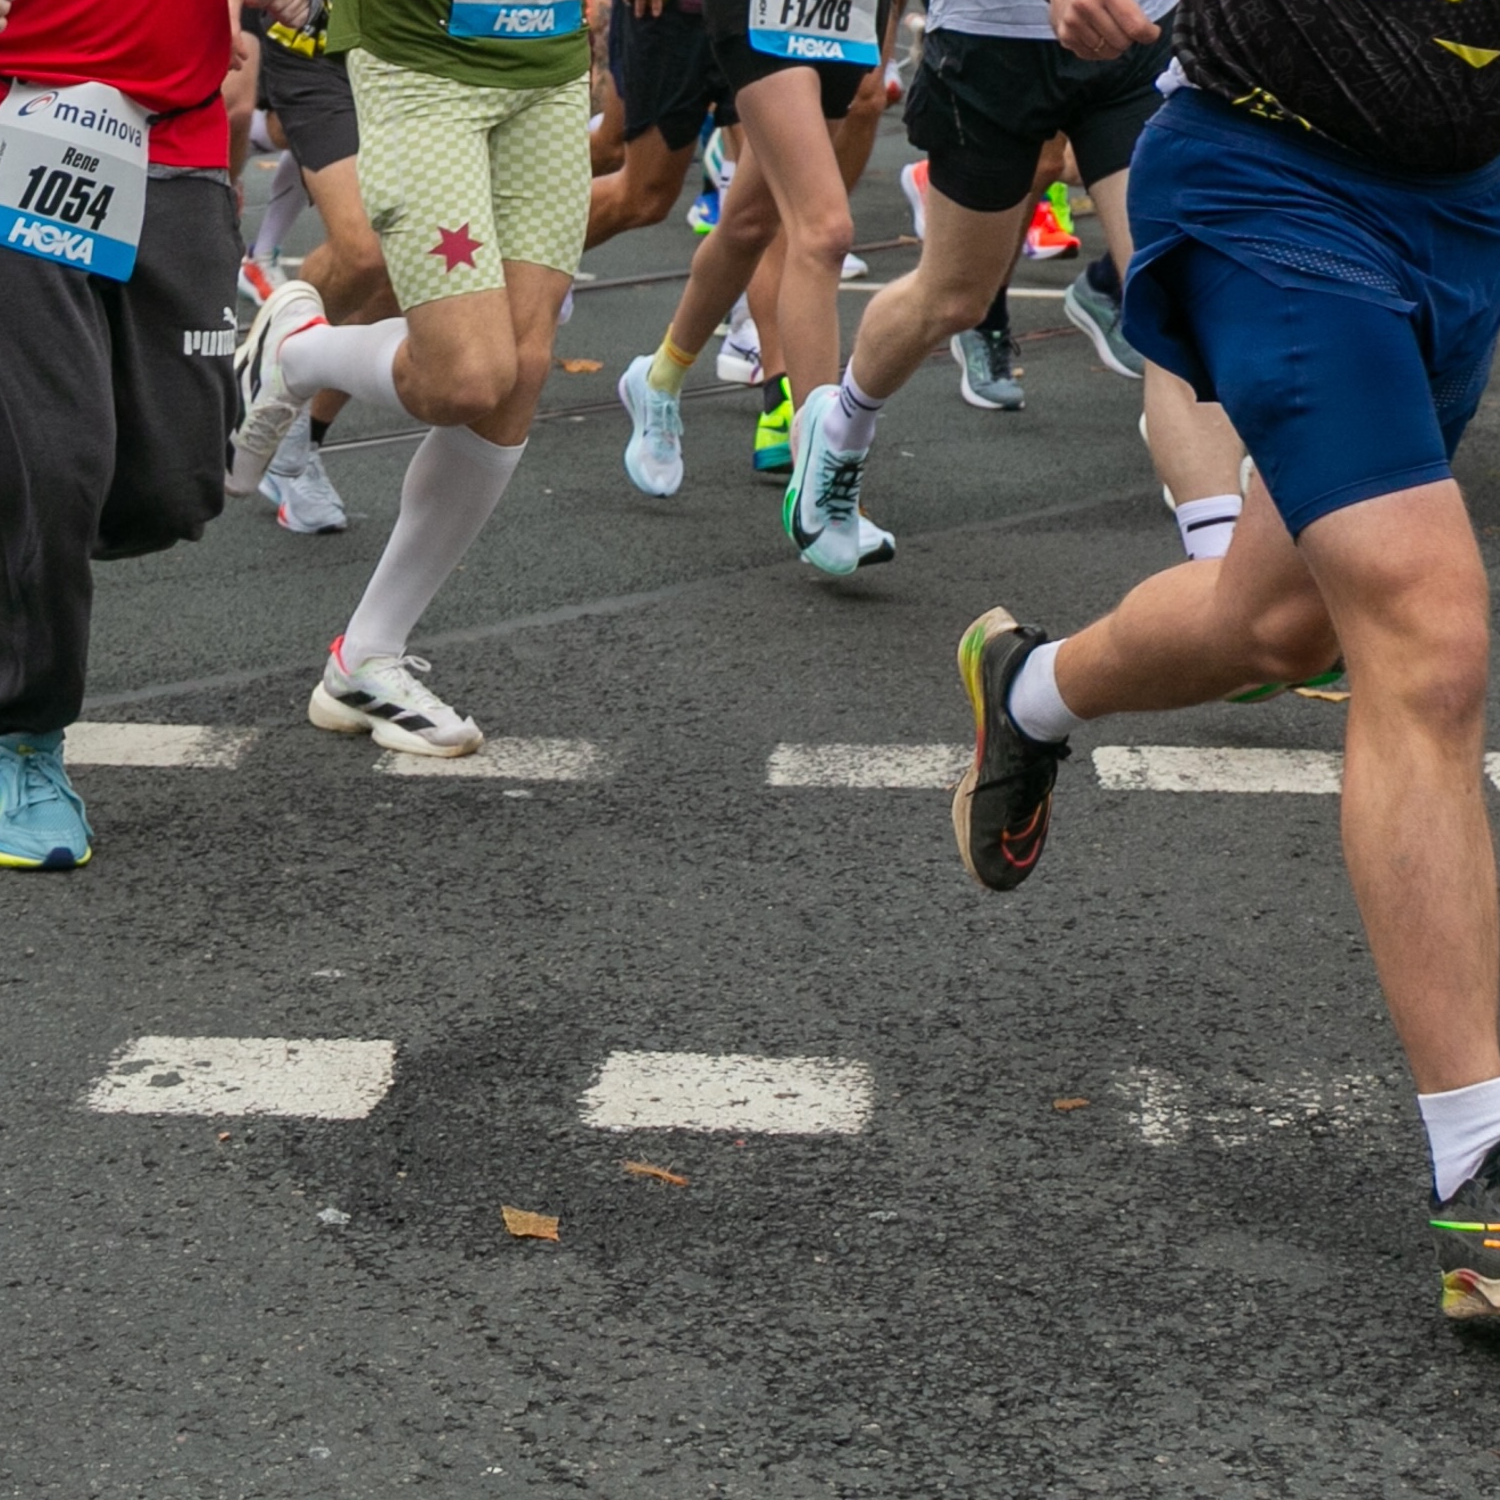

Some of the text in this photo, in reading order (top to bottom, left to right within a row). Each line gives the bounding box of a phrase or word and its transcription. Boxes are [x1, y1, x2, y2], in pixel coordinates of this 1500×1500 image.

[493, 7, 555, 32] HOKA
[787, 35, 845, 59] HOKA
[54, 102, 142, 148] mainova
[61, 146, 100, 173] Rene
[18, 165, 116, 231] 1054
[7, 217, 95, 266] HOKA
